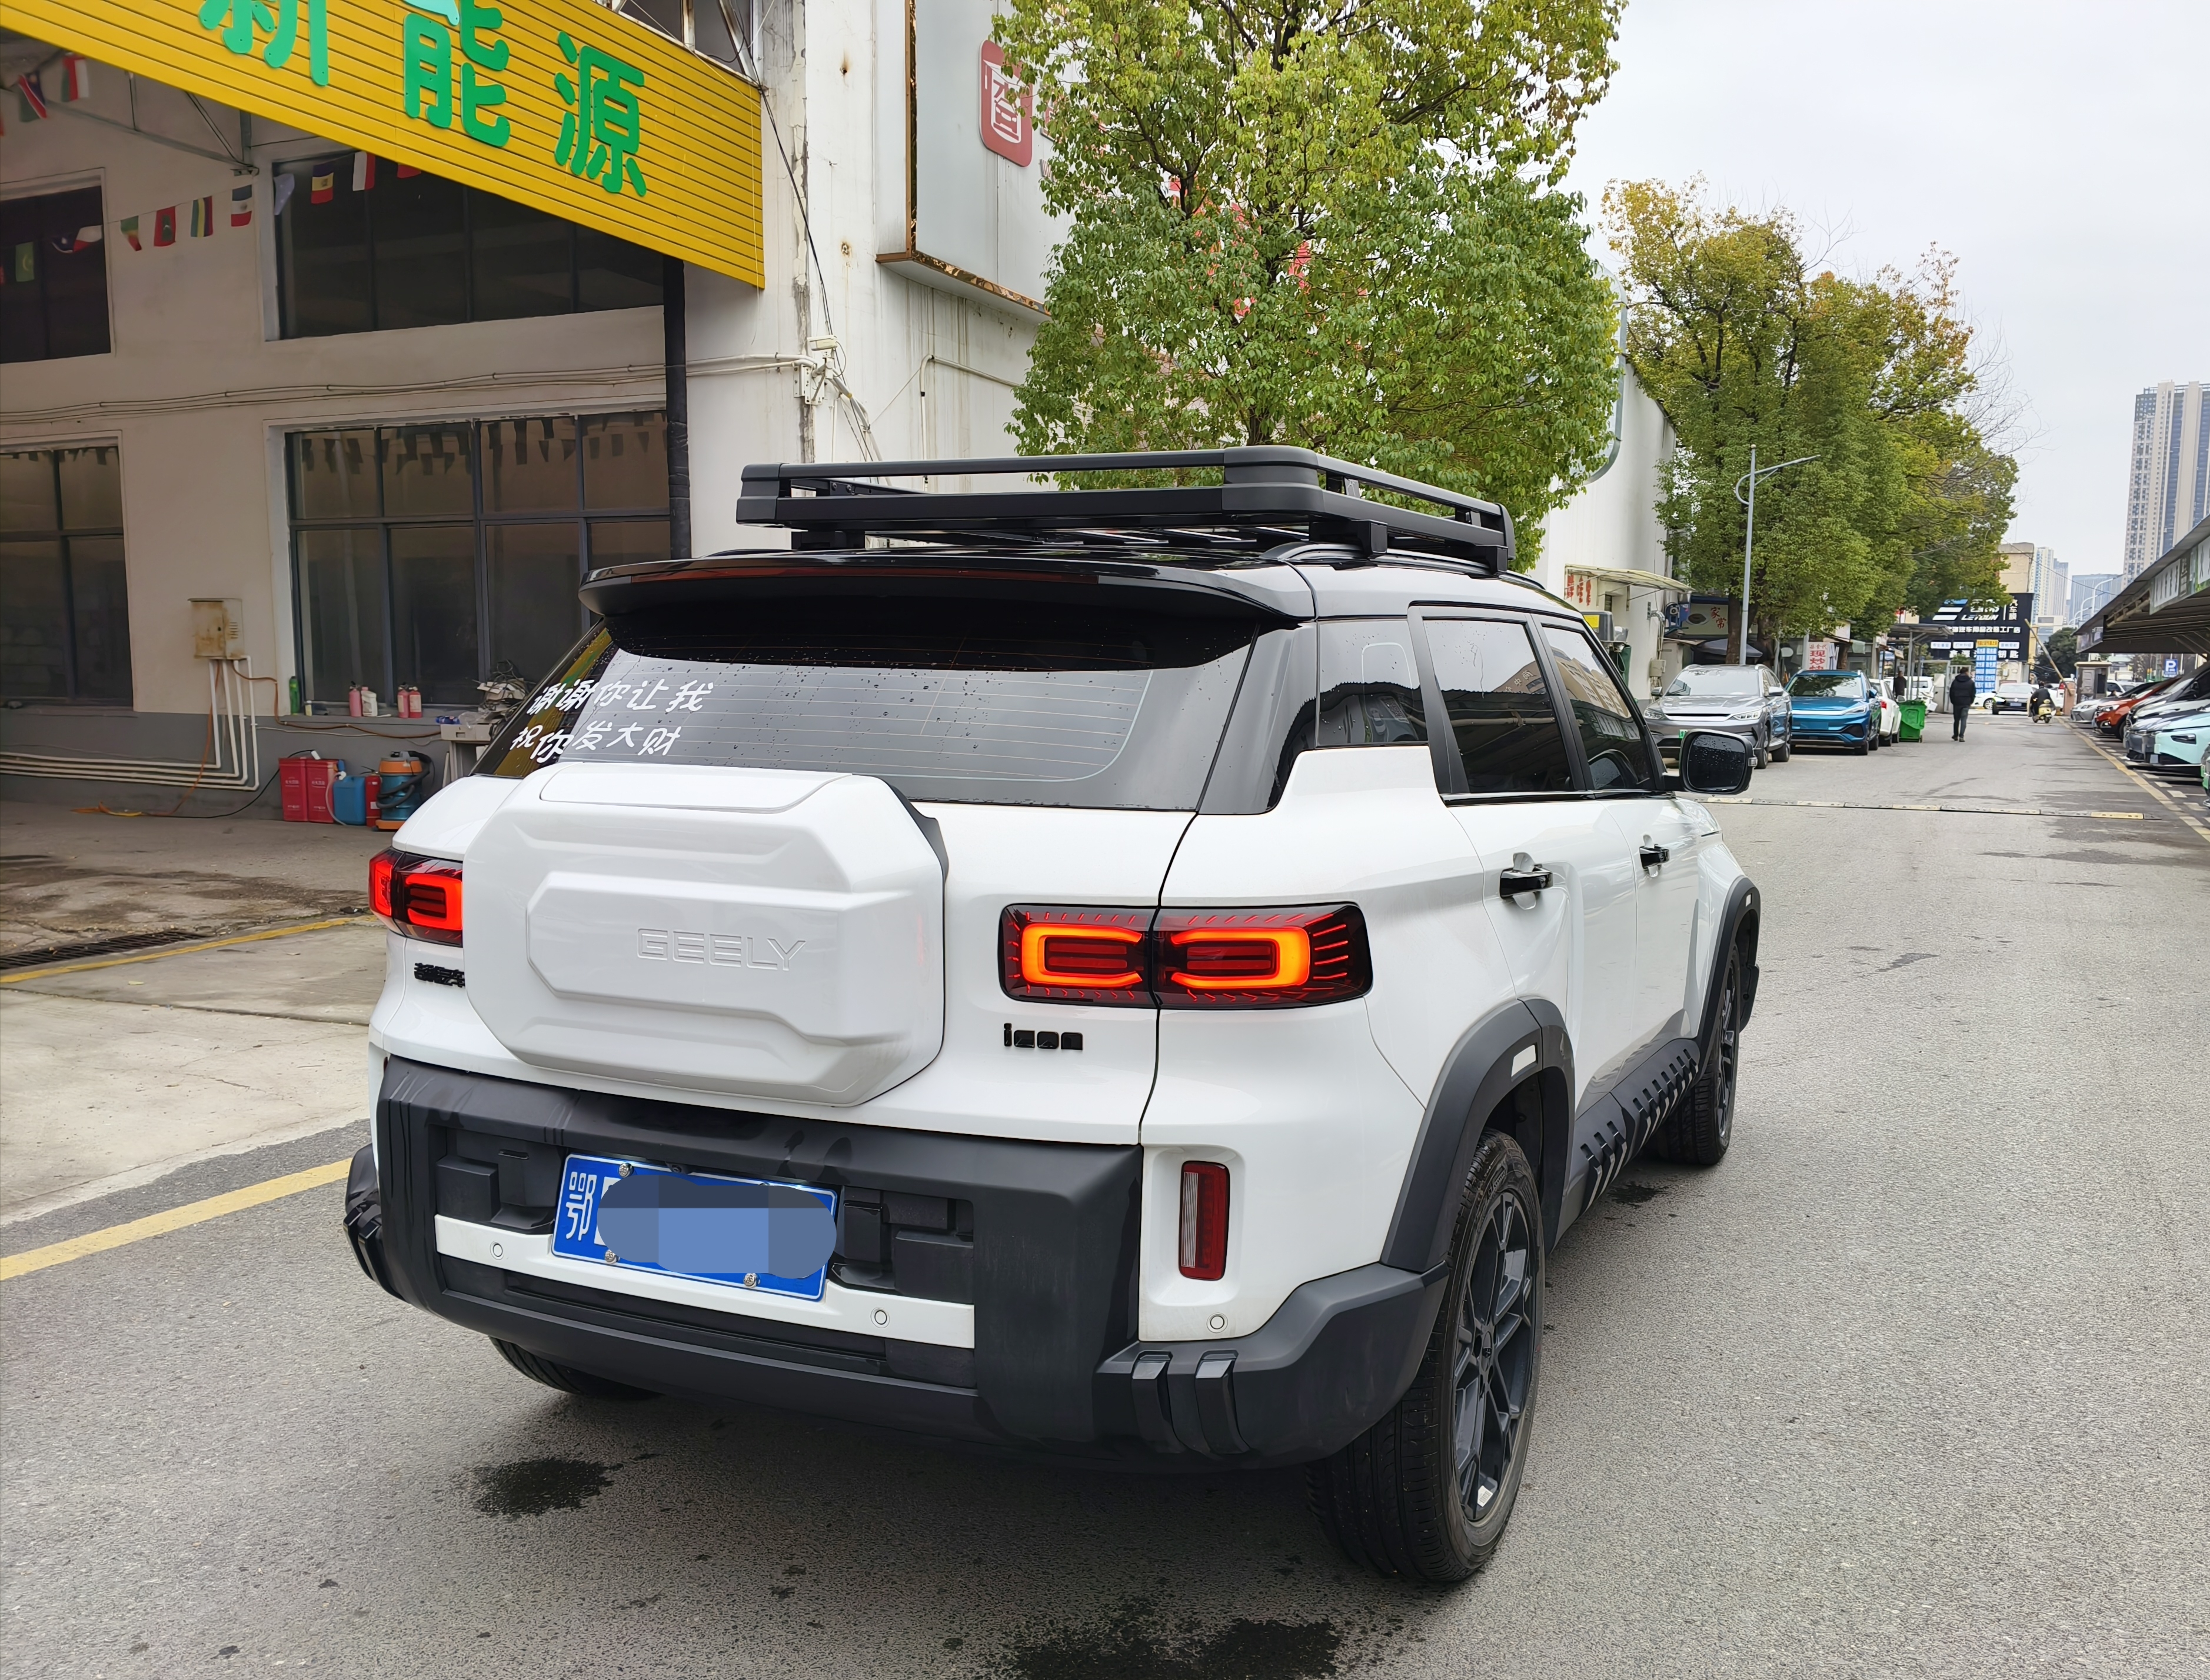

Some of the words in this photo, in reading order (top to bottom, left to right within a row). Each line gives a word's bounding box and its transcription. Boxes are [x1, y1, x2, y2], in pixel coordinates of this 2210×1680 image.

[2165, 660, 2176, 672] P
[527, 678, 714, 715] 谢谢你让我
[510, 720, 681, 763] 祝你发大财
[637, 928, 806, 971] GEELY
[565, 1171, 597, 1241] 鄂
